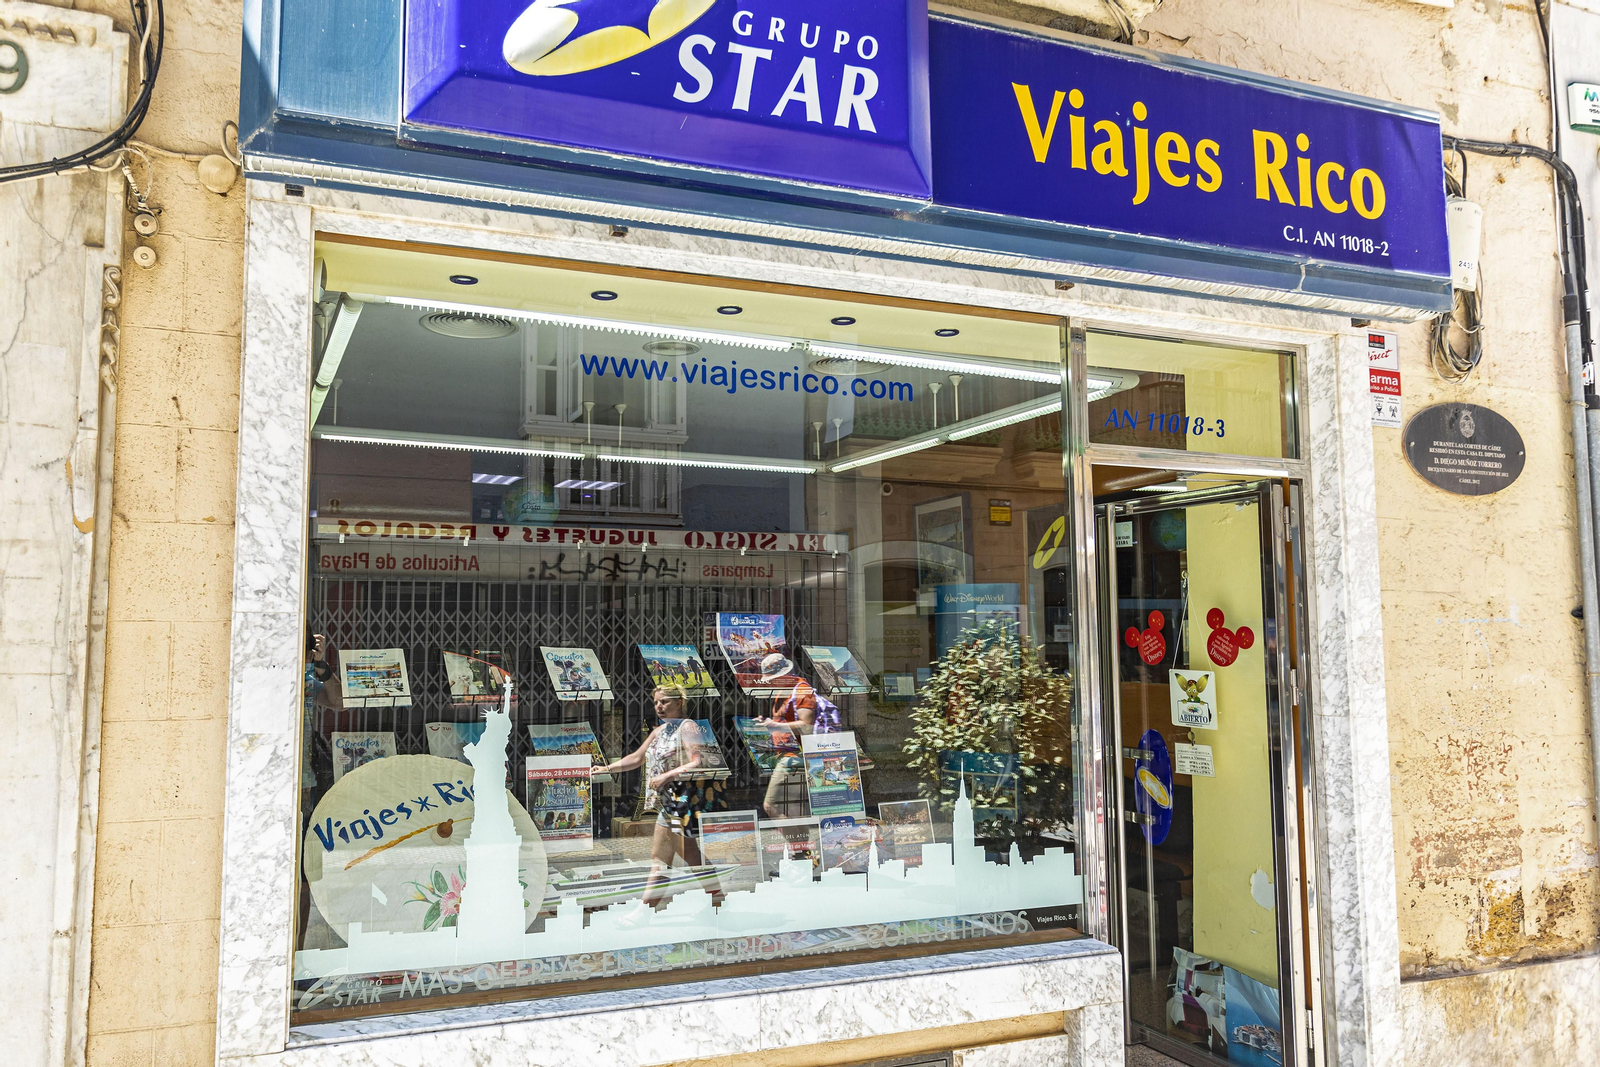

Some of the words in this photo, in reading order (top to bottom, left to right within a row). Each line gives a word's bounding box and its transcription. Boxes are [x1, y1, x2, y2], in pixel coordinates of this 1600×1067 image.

[732, 10, 878, 60] GRUPO
[0, 39, 29, 94] 9
[672, 34, 879, 134] STAR
[1011, 81, 1223, 206] Viajes
[1252, 128, 1386, 220] Rico
[1283, 224, 1309, 245] C.I.
[1313, 229, 1336, 248] AN
[1339, 234, 1390, 257] 11018-2
[579, 353, 914, 402] www.viajesrico.com
[1104, 408, 1139, 430] AN
[1147, 412, 1225, 438] 11018-3
[1440, 457, 1458, 465] DIEGO
[1458, 458, 1477, 467] MUÑOZ
[1478, 461, 1502, 469] TORRERO
[1147, 650, 1162, 662] Disney
[1210, 648, 1227, 664] Disney
[1180, 713, 1209, 724] ABIERTO
[572, 768, 589, 777] Mayo
[313, 801, 413, 853] Viajes
[1036, 915, 1053, 923] Viajes
[1053, 914, 1067, 922] Rico,
[399, 966, 463, 999] MAS
[473, 953, 592, 991] OFERTAS
[602, 950, 636, 978] EN
[647, 946, 673, 972] EL
[682, 934, 794, 969] INTERIOR
[866, 910, 1028, 949] CONSULTENOS
[333, 986, 383, 1007] STAR
[347, 979, 383, 989] GRUPO
[332, 1004, 382, 1013] VIAJES
